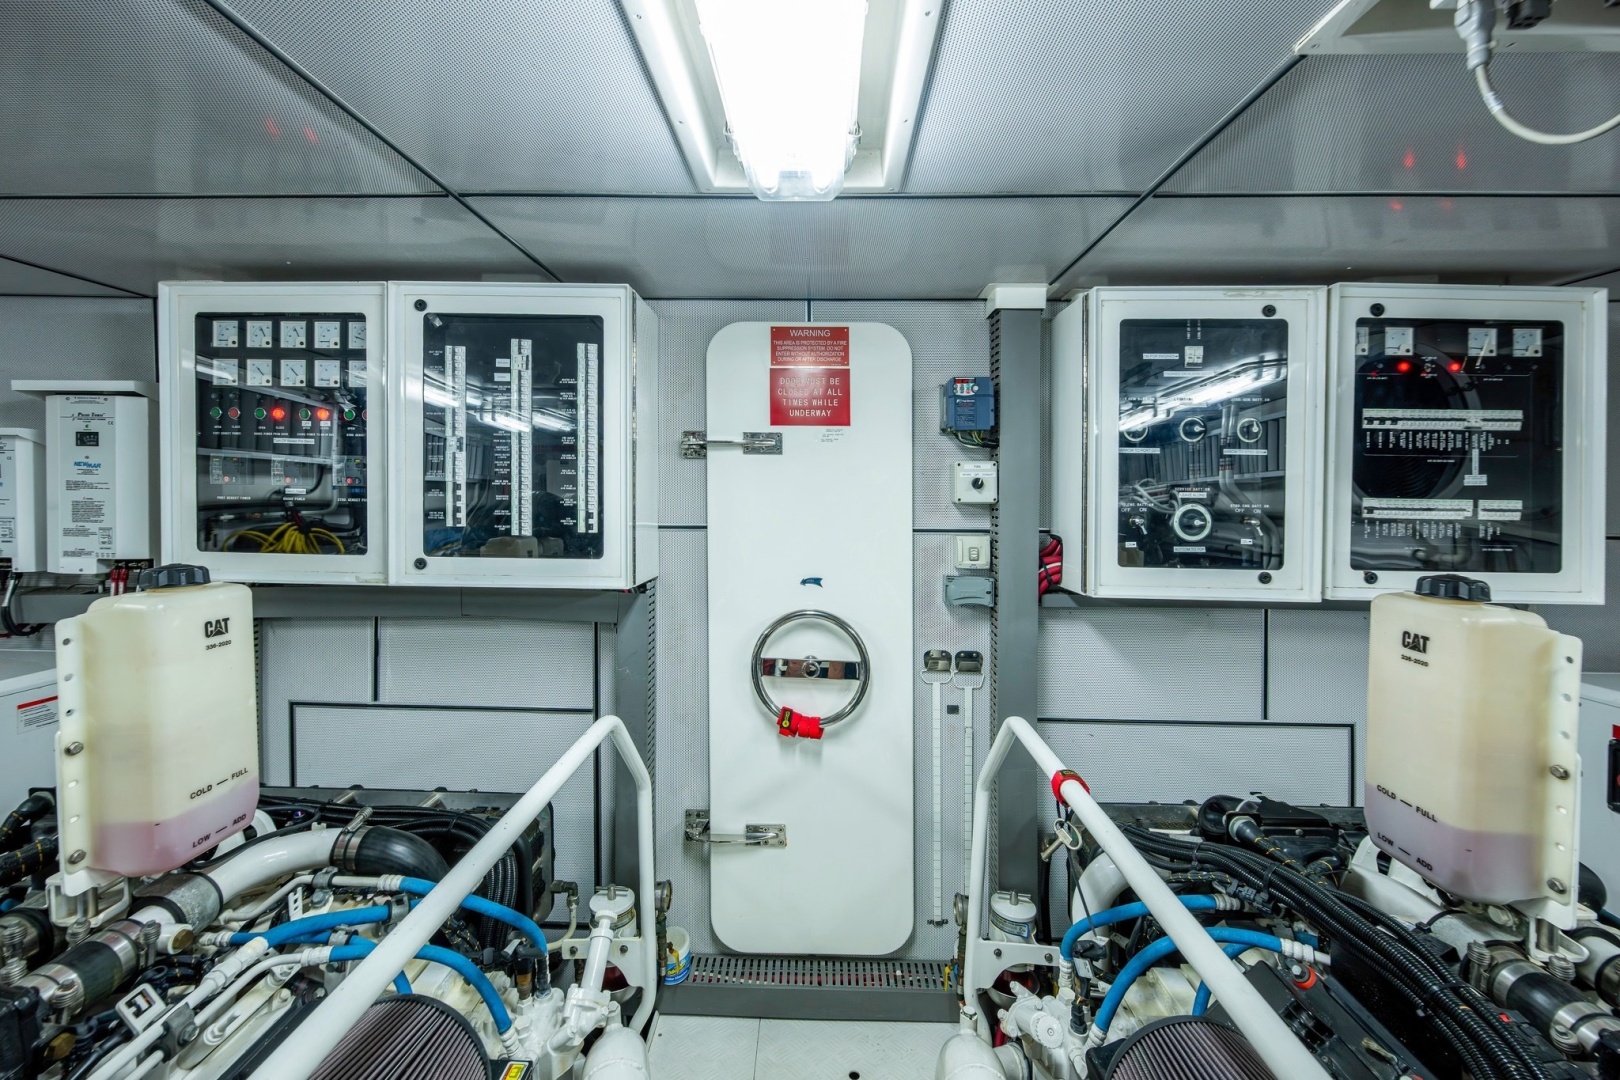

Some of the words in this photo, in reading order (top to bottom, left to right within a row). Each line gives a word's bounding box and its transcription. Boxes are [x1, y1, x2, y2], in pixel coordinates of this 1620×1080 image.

[204, 617, 230, 638] CAT
[1402, 631, 1430, 654] CAT
[190, 784, 213, 799] COLD
[231, 768, 248, 780] FULL
[1376, 784, 1396, 800] COLD
[1416, 806, 1437, 822] FULL
[192, 833, 211, 848] LOW
[232, 813, 246, 826] ADD
[1377, 832, 1394, 846] LOW
[1416, 857, 1433, 872] ADD
